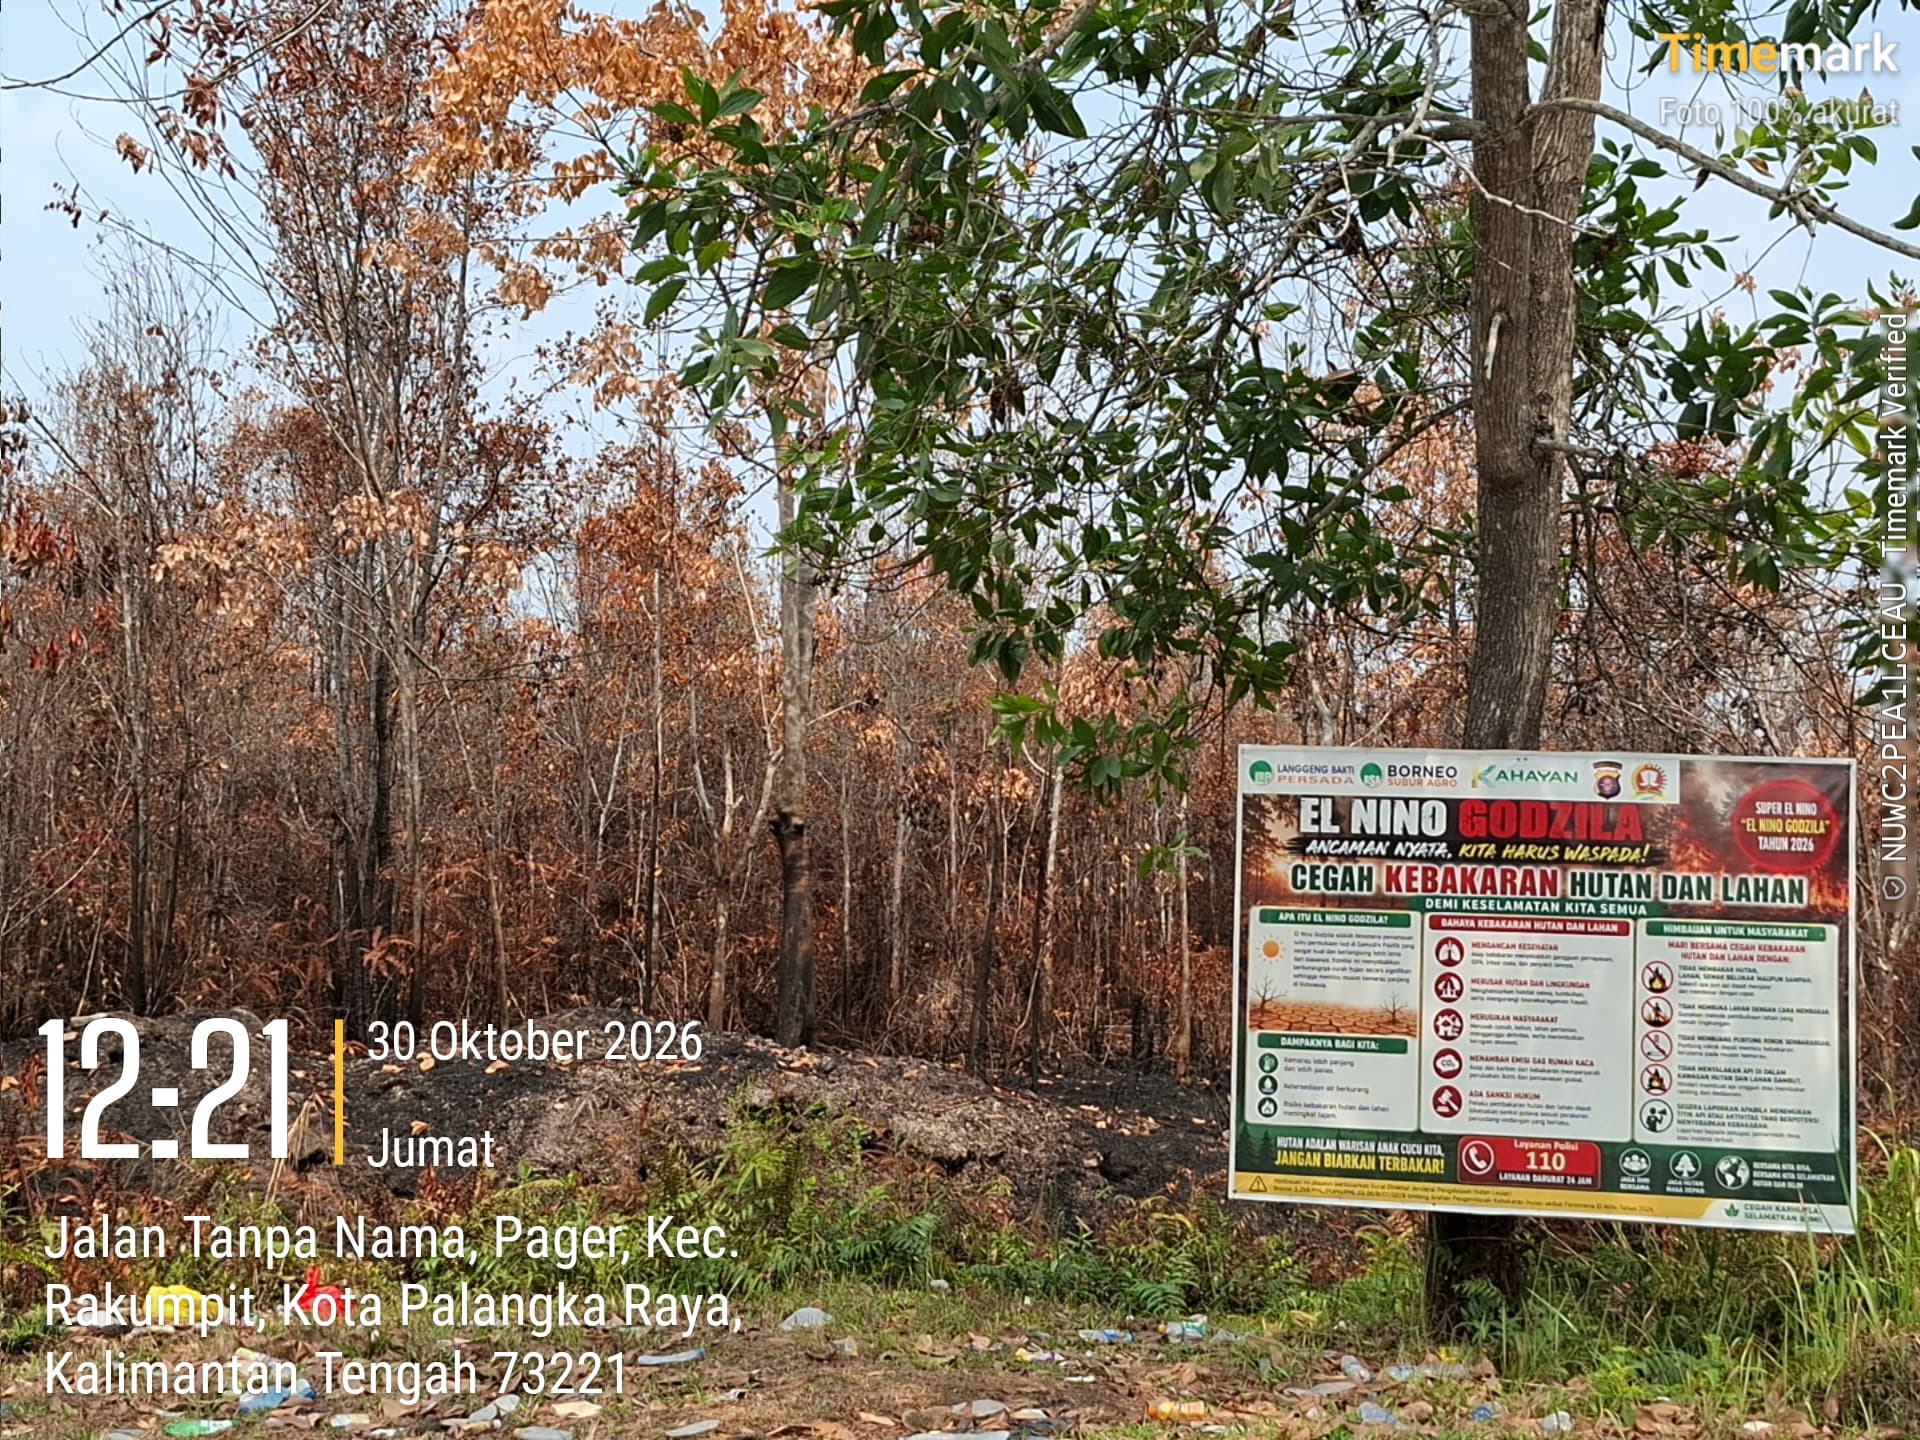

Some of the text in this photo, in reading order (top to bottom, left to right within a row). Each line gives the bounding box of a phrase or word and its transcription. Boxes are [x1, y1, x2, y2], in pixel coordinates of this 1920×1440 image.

[1277, 764, 1355, 775] LANGGENG BAKTI
[1387, 764, 1458, 778] BORNEO
[1471, 764, 1578, 788] KAHAYAN
[1277, 775, 1355, 785] PERSADA
[1388, 778, 1424, 787] SUBUR
[1427, 779, 1458, 788] AGRO
[1755, 801, 1817, 817] SUPER EL NINO
[1300, 797, 1644, 842] EL NINO GODZILA
[1759, 819, 1783, 833] NINO
[1758, 836, 1815, 851] TAHUN 2026
[1305, 840, 1650, 863] ANCAMAN NYATA, KITA HARUS WASPADA!
[1291, 864, 1804, 905] CEGAH KEBAKARAN HUTAN DAN LAHAN
[1425, 898, 1648, 916] DEMI KESELAMATAN KITA SEMUA
[1278, 912, 1388, 924] APA ITU EL NINO GODZILA?
[1441, 918, 1618, 932] BAHAYA KEBAKARAN HUTAN DAN LAHAN
[1663, 924, 1808, 938] HIMBAUAN UNTUK MASYARAKAT
[1471, 942, 1558, 951] MENGANCAM KESEHATAN
[1690, 942, 1728, 950] BERSAMA
[1730, 943, 1756, 951] CEGAH
[1758, 944, 1806, 953] KEBAKARAN
[1681, 952, 1707, 961] HUTAN
[1709, 953, 1725, 961] DAN
[1728, 953, 1754, 962] LAHAN
[1471, 978, 1590, 989] MERUSAK HUTAN DAN LINGKUNGAN
[1470, 1014, 1558, 1023] MERUGIKAN MASYARAKAT
[1280, 1036, 1380, 1050] DAMPAKNYA BAGI KITA:
[1469, 1055, 1594, 1067] MENAMBAH EMISI GAS RUMAH KACA
[1469, 1090, 1541, 1100] ADA SANKSI HUKUM
[1277, 1136, 1303, 1148] HUTAN
[1305, 1137, 1337, 1150] ADALAH
[1338, 1139, 1375, 1152] WARISAN
[1377, 1141, 1399, 1153] ANAK
[1401, 1142, 1422, 1155] CUCU
[1514, 1139, 1578, 1151] Layanan Polisi
[1275, 1150, 1445, 1175] JANGAN BIARKAN TERBAKAR!
[1526, 1151, 1566, 1171] 110
[1499, 1172, 1592, 1186] LAYANAN DARURAT 24 JAM
[1744, 1203, 1773, 1212] CEGAH
[1744, 1212, 1797, 1222] SELAMATKAN
